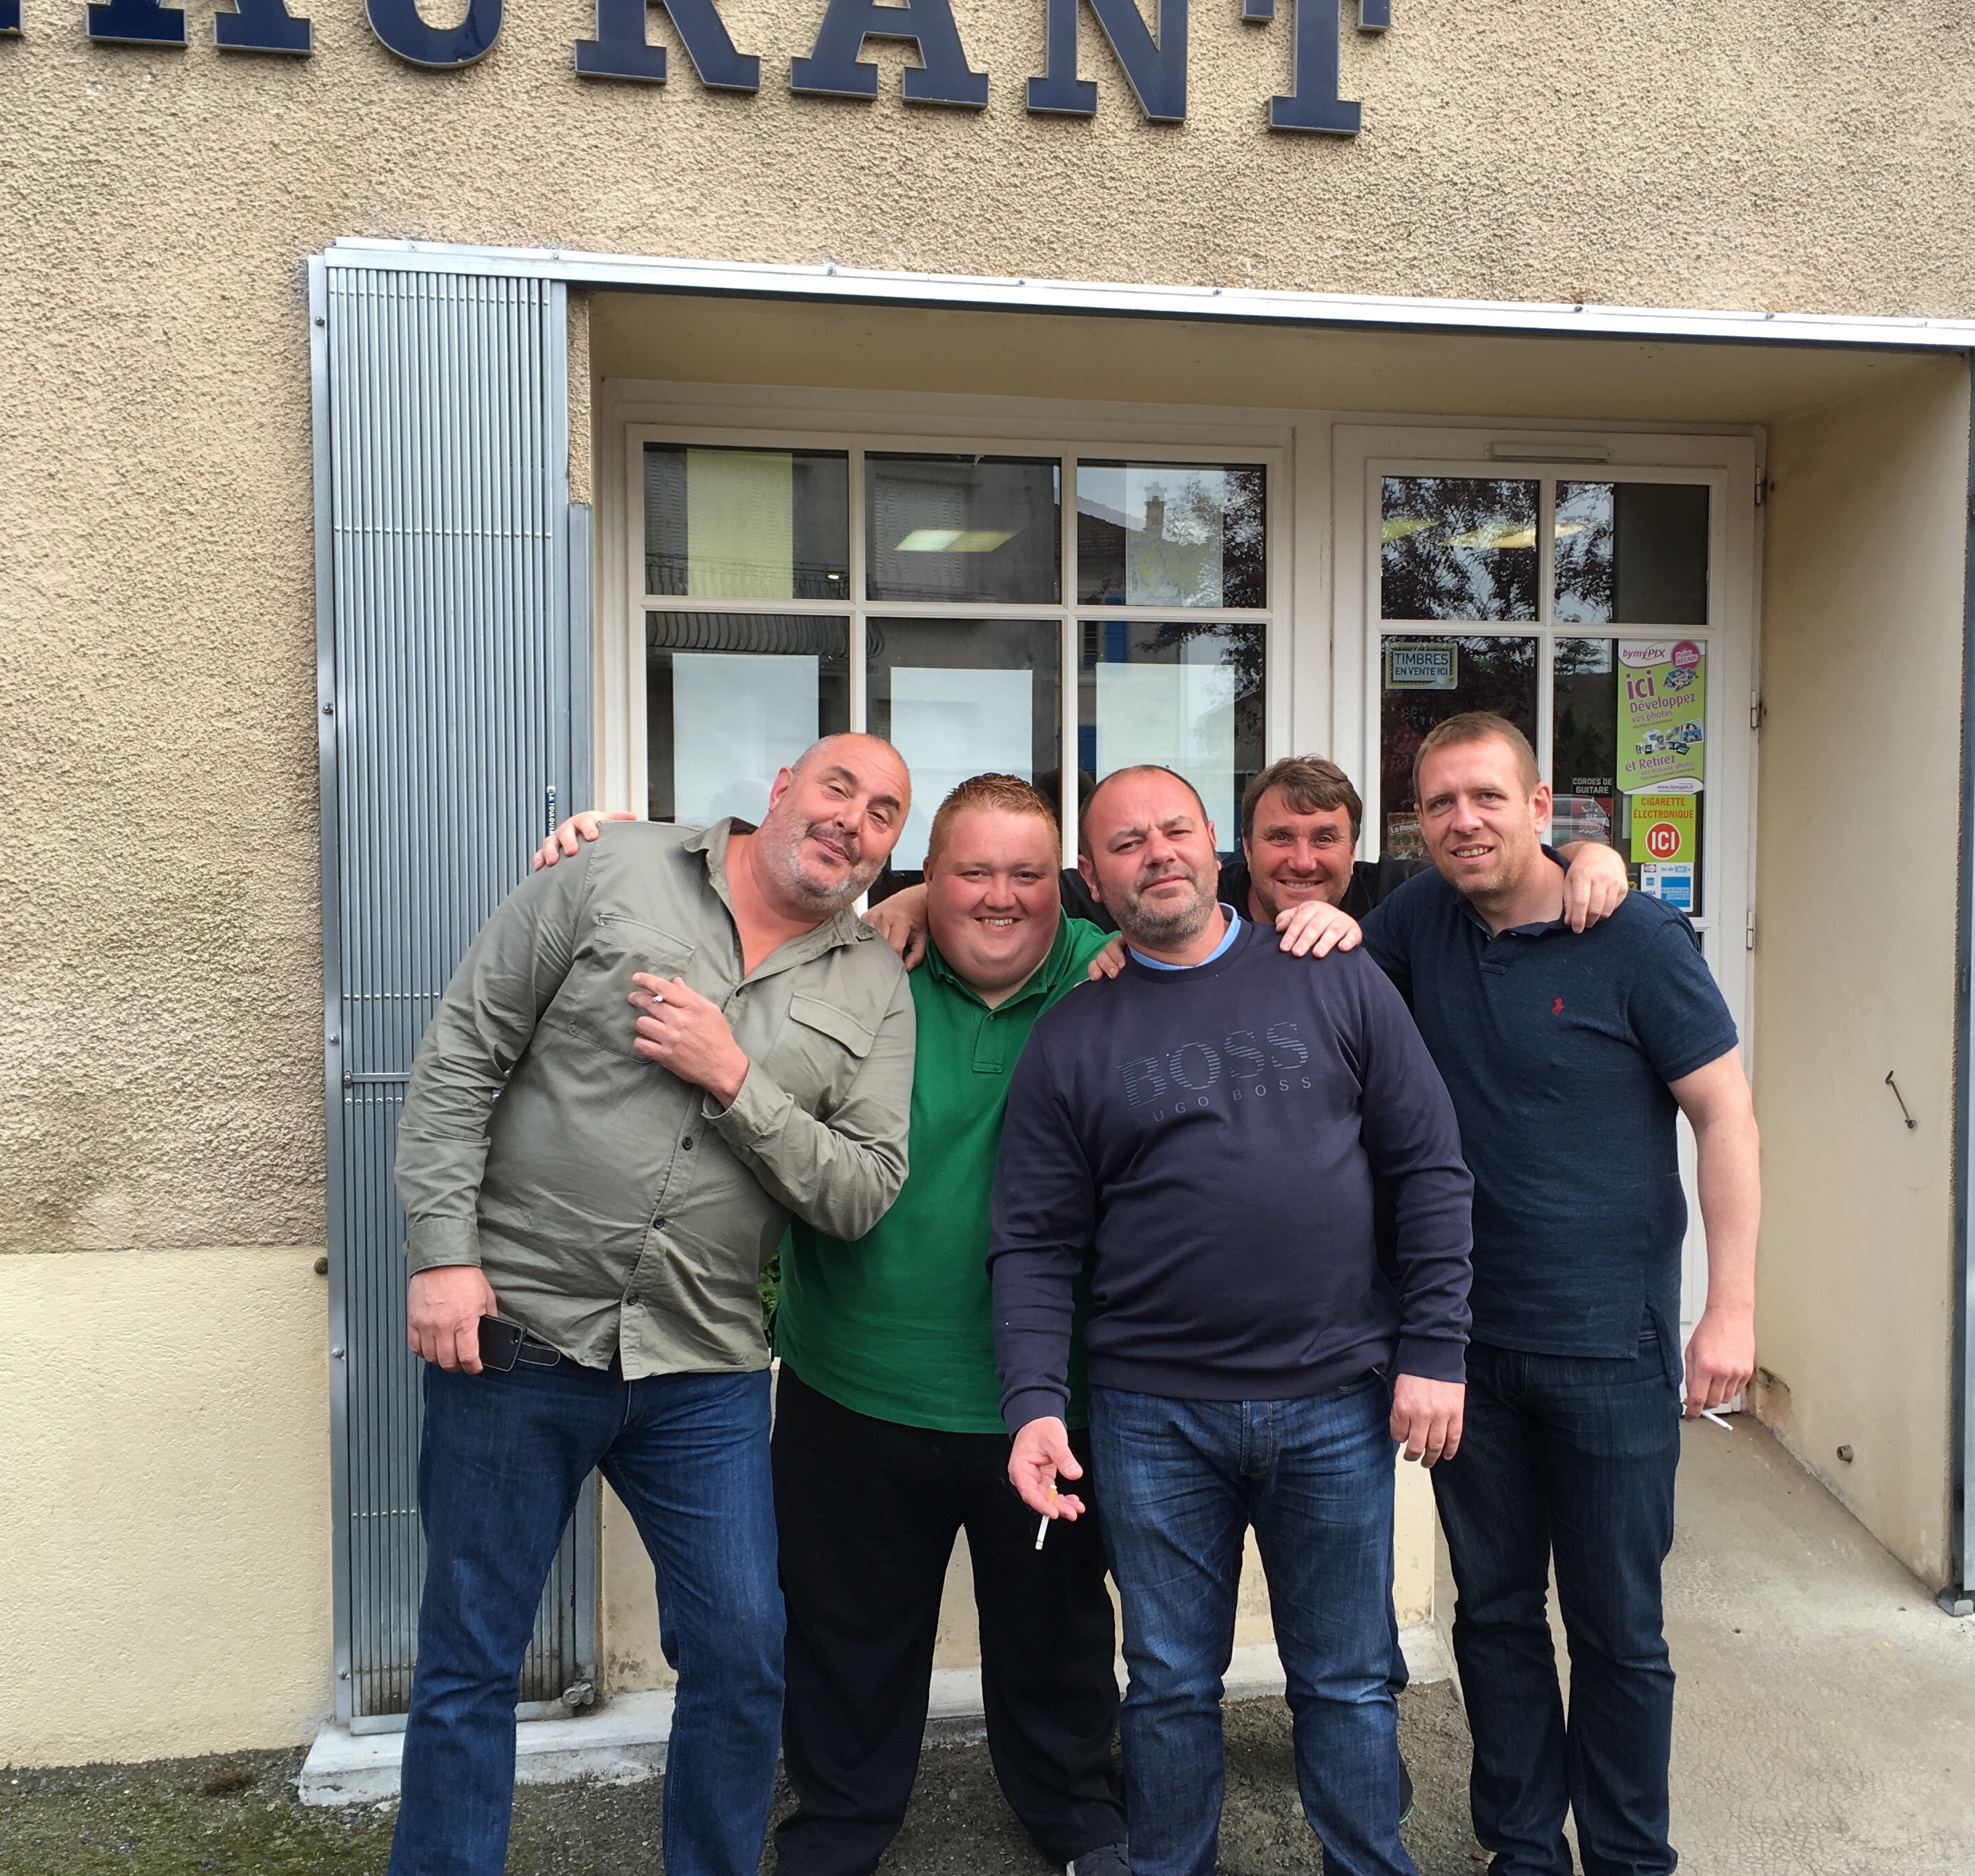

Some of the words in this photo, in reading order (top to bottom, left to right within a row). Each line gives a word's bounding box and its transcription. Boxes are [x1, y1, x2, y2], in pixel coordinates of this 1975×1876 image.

[1394, 653, 1448, 665] TIMBRES
[1623, 649, 1666, 659] bymyPIX
[1677, 655, 1698, 664] RELAIS
[1395, 667, 1407, 675] EN
[1626, 669, 1655, 700] ici
[1630, 693, 1696, 713] Développez
[1647, 710, 1673, 722] photos
[1626, 762, 1637, 772] et
[1640, 755, 1676, 770] Retirez
[1675, 761, 1695, 770] photos
[1575, 786, 1609, 794] GUITARE
[1641, 797, 1686, 806] CIGARETTE
[1633, 808, 1694, 819] ÉLECTRONIQUE
[1651, 831, 1675, 851] ICI
[1117, 1022, 1308, 1110] BOSS
[1151, 1096, 1209, 1122] UGO
[1232, 1076, 1312, 1101] BOSS
